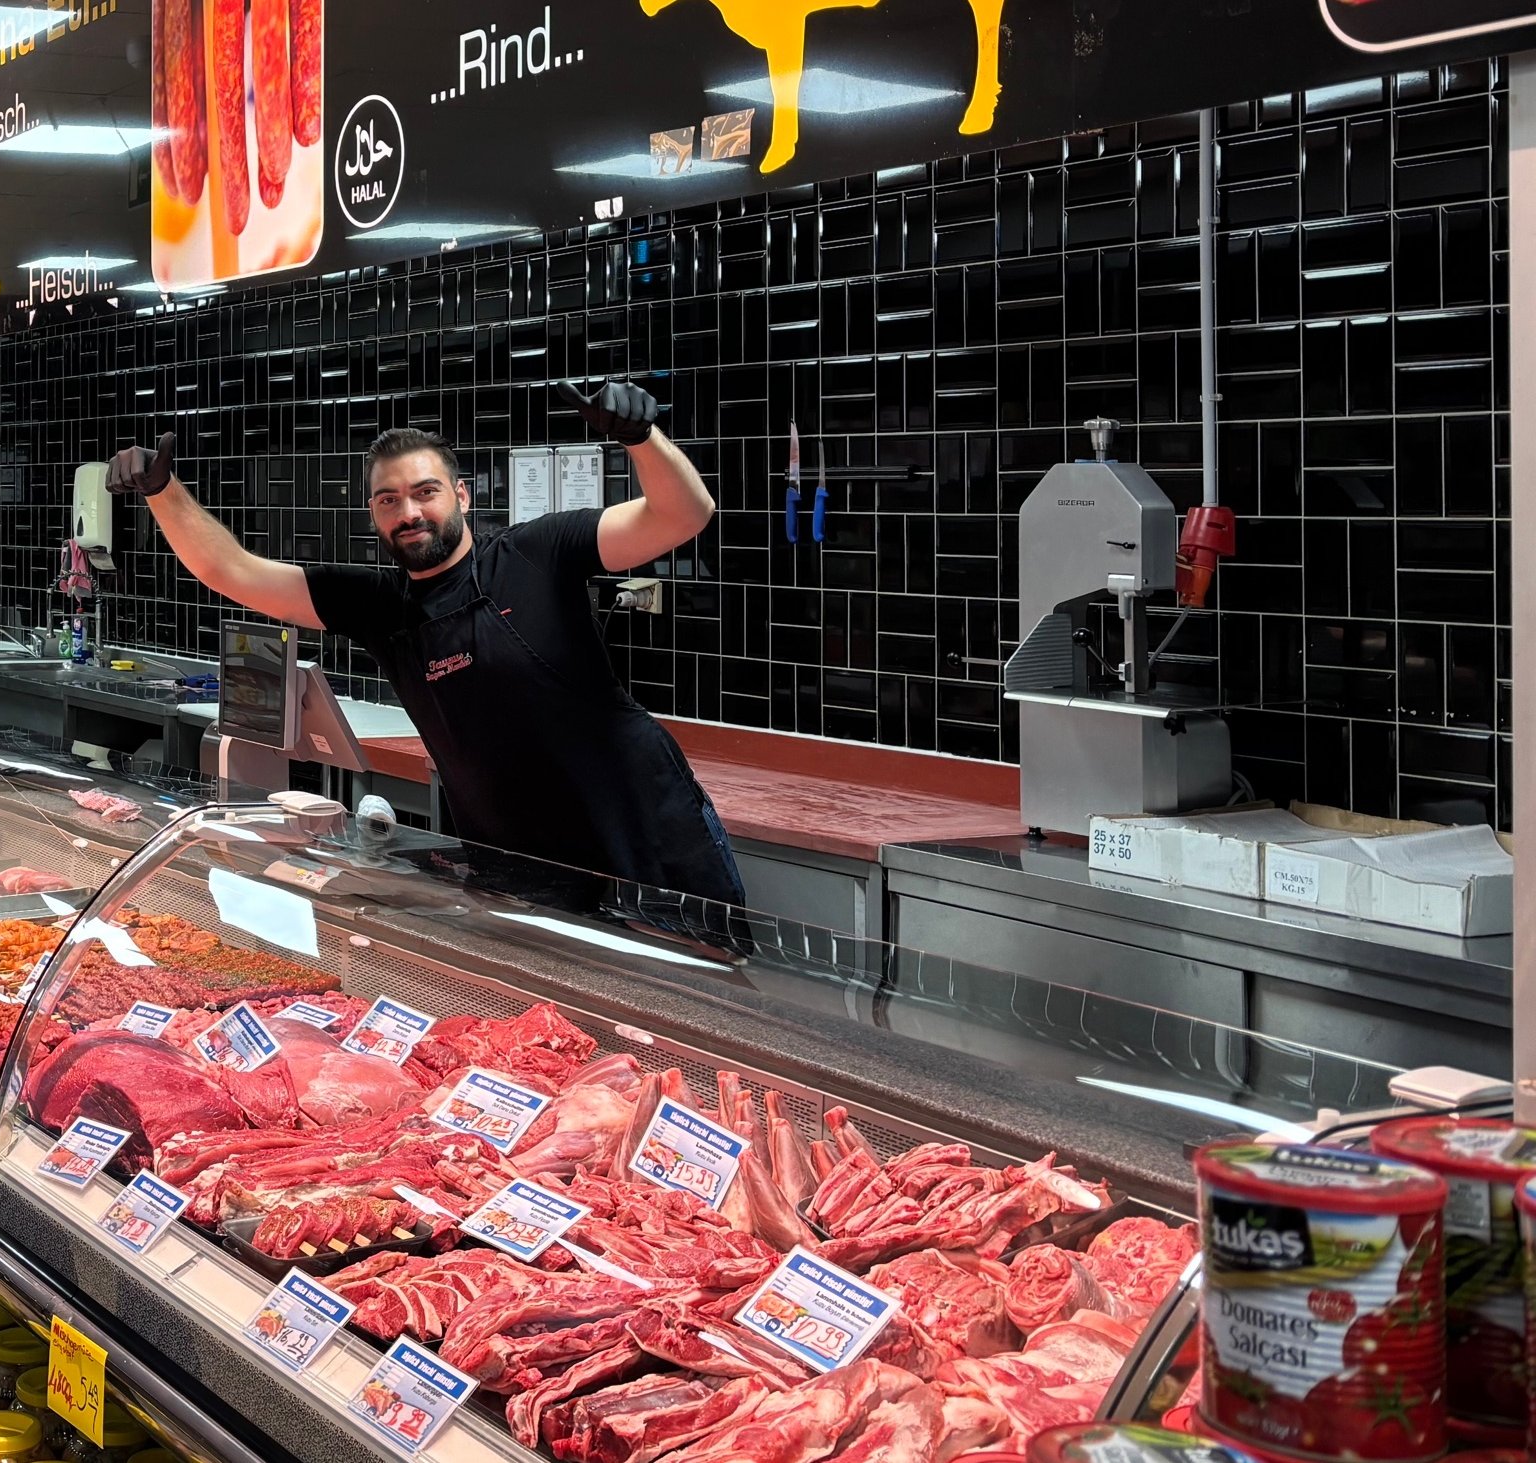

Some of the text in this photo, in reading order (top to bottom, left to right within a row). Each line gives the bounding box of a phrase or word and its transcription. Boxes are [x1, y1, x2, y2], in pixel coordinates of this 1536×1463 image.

[431, 6, 583, 104] ...Rind...
[345, 119, 393, 176] حلال
[351, 184, 386, 205] HALAL
[16, 251, 114, 309] ...Fleisch...
[1093, 843, 1132, 860] 37 x 50
[1094, 829, 1132, 846] 25 x 37
[1274, 870, 1313, 886] CM.50X75
[1281, 883, 1306, 895] KG.15
[1212, 1216, 1304, 1257] tukaş
[798, 1262, 822, 1281] täglich
[842, 1285, 874, 1309] günstig!
[816, 1291, 846, 1311] Lammhals
[1221, 1292, 1319, 1342] Domates
[1229, 1324, 1308, 1369] Salçası
